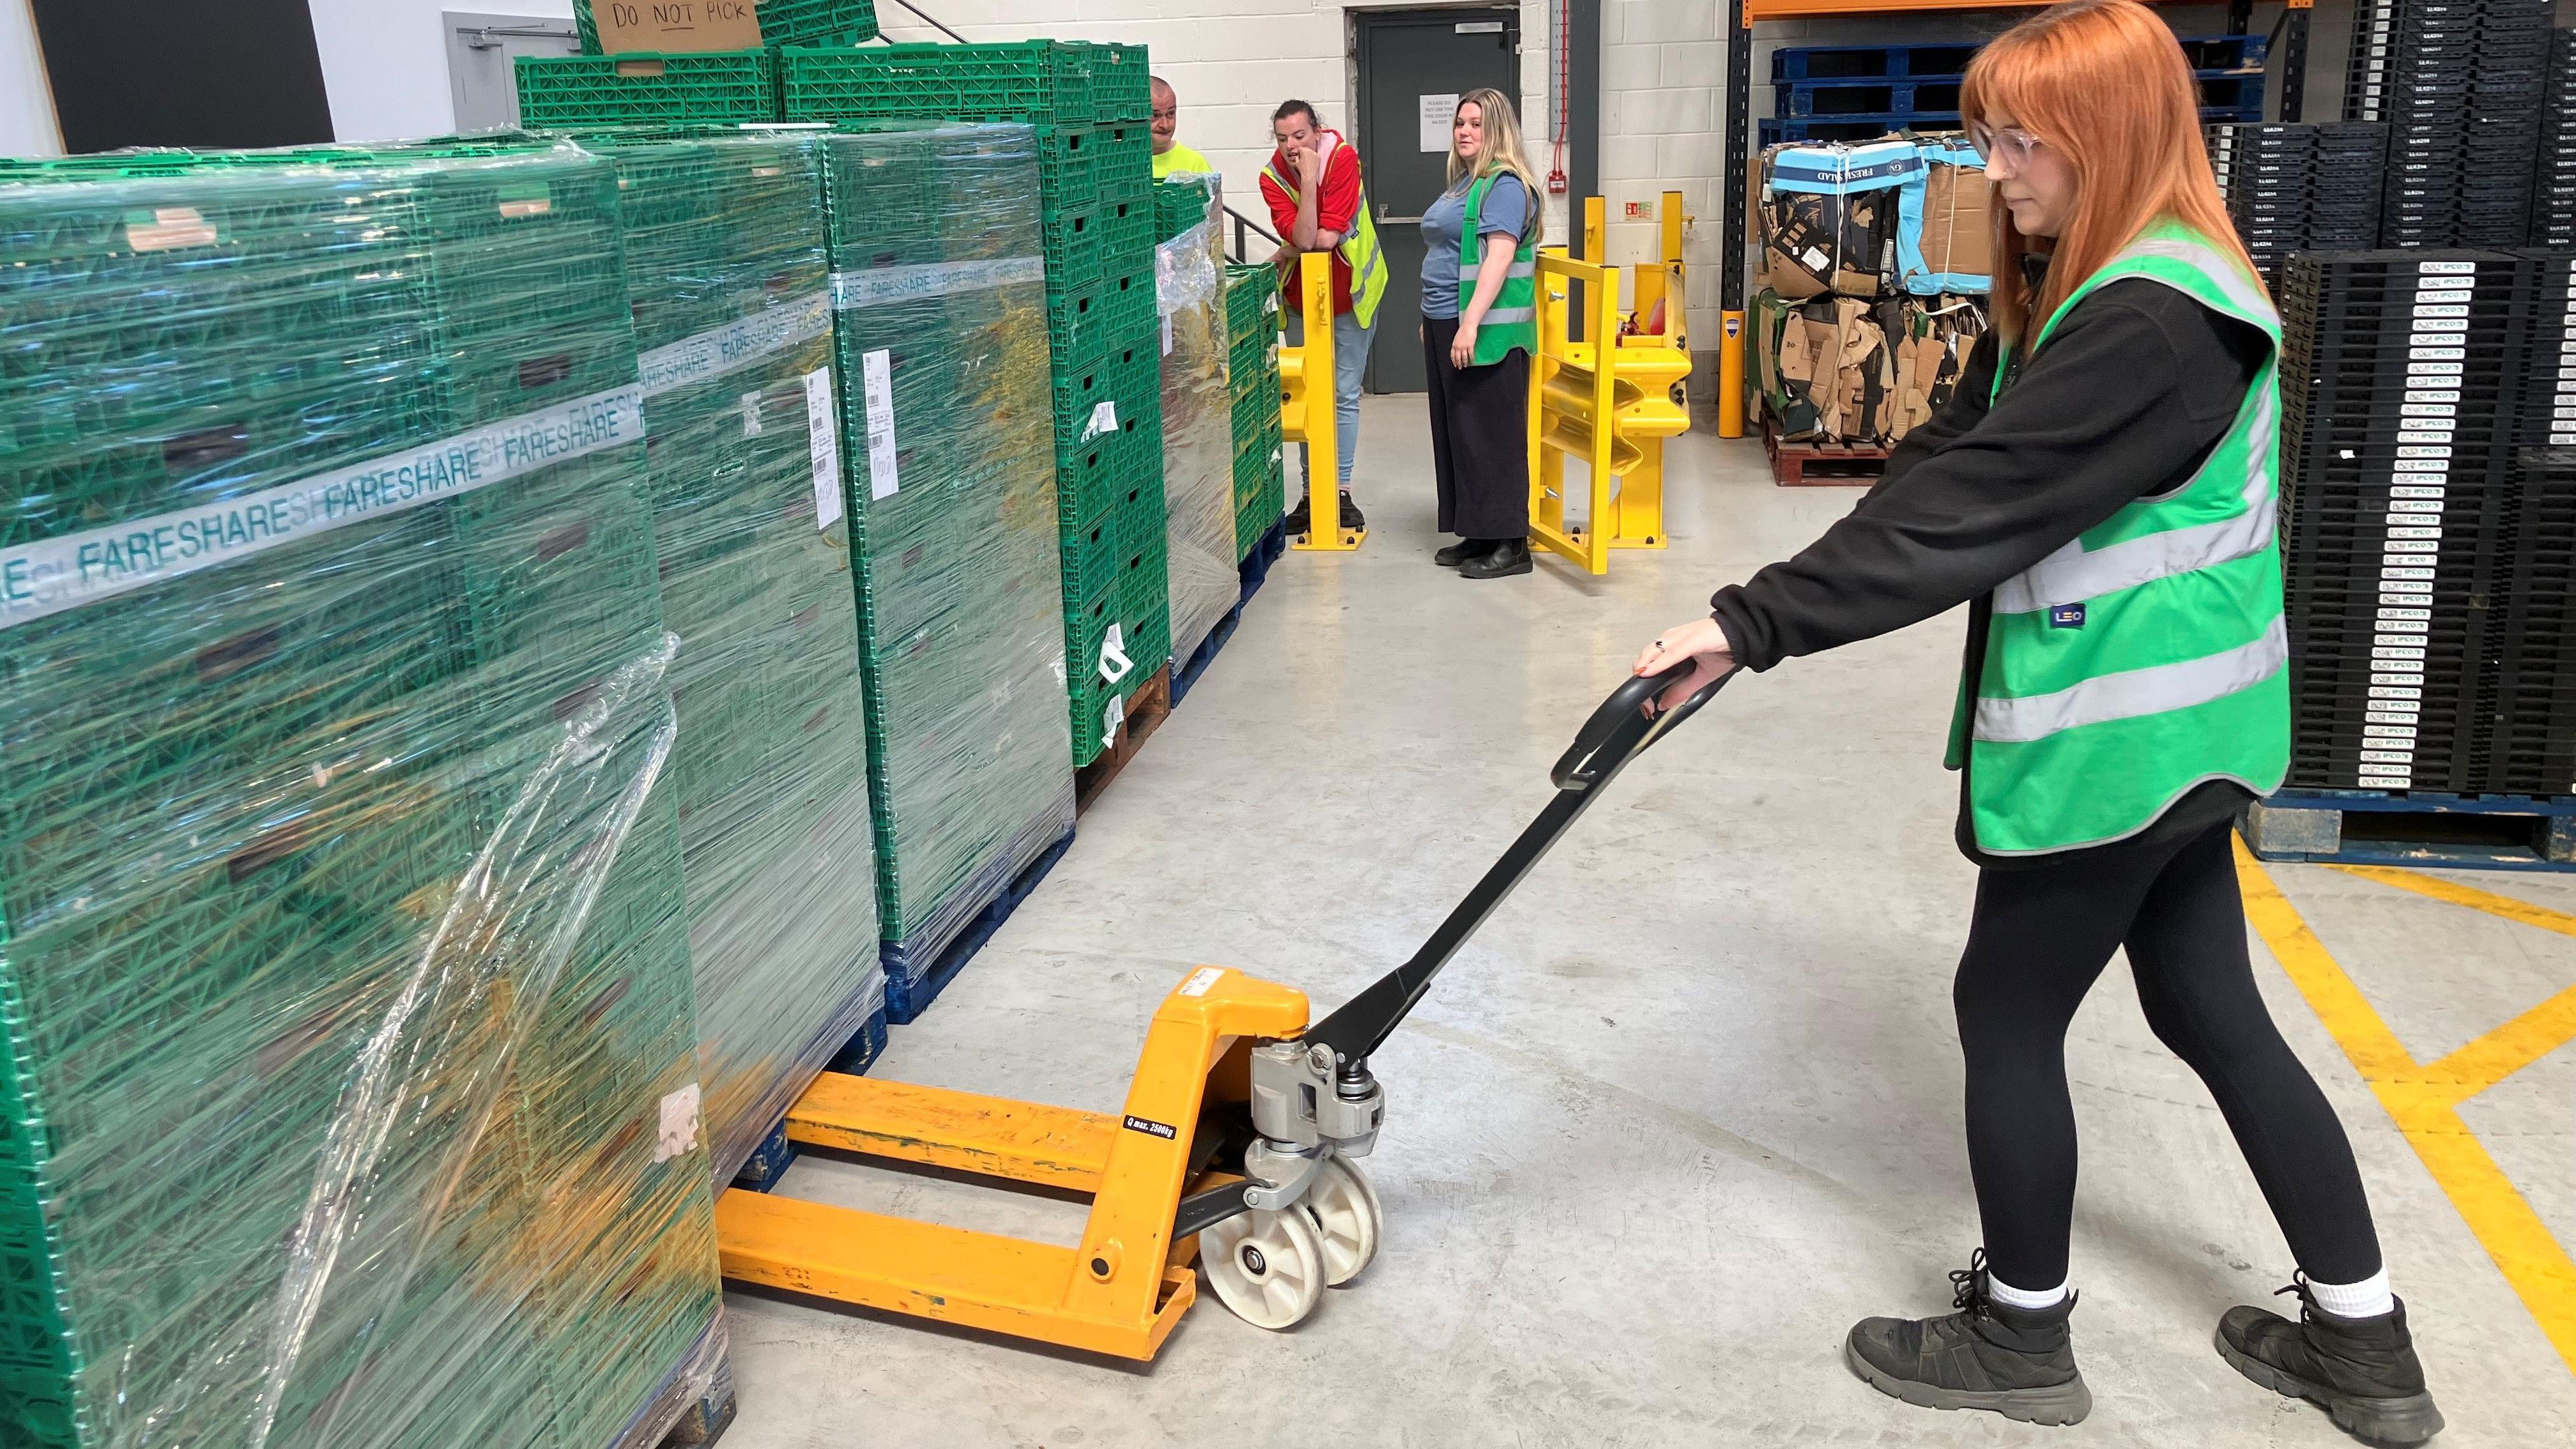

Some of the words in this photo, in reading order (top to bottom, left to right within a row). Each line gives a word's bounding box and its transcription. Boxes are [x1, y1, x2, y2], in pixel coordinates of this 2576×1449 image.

[612, 3, 638, 29] DO
[653, 3, 694, 24] NOT
[706, 1, 747, 23] PICK
[77, 497, 292, 583] FARESHARE
[325, 448, 482, 521] FARESHARE
[504, 410, 620, 469] FARESHARE
[2055, 611, 2083, 622] LEO
[1126, 1117, 1134, 1127] Q
[1133, 1120, 1149, 1130] max.
[1149, 1123, 1174, 1138] 2500kg
